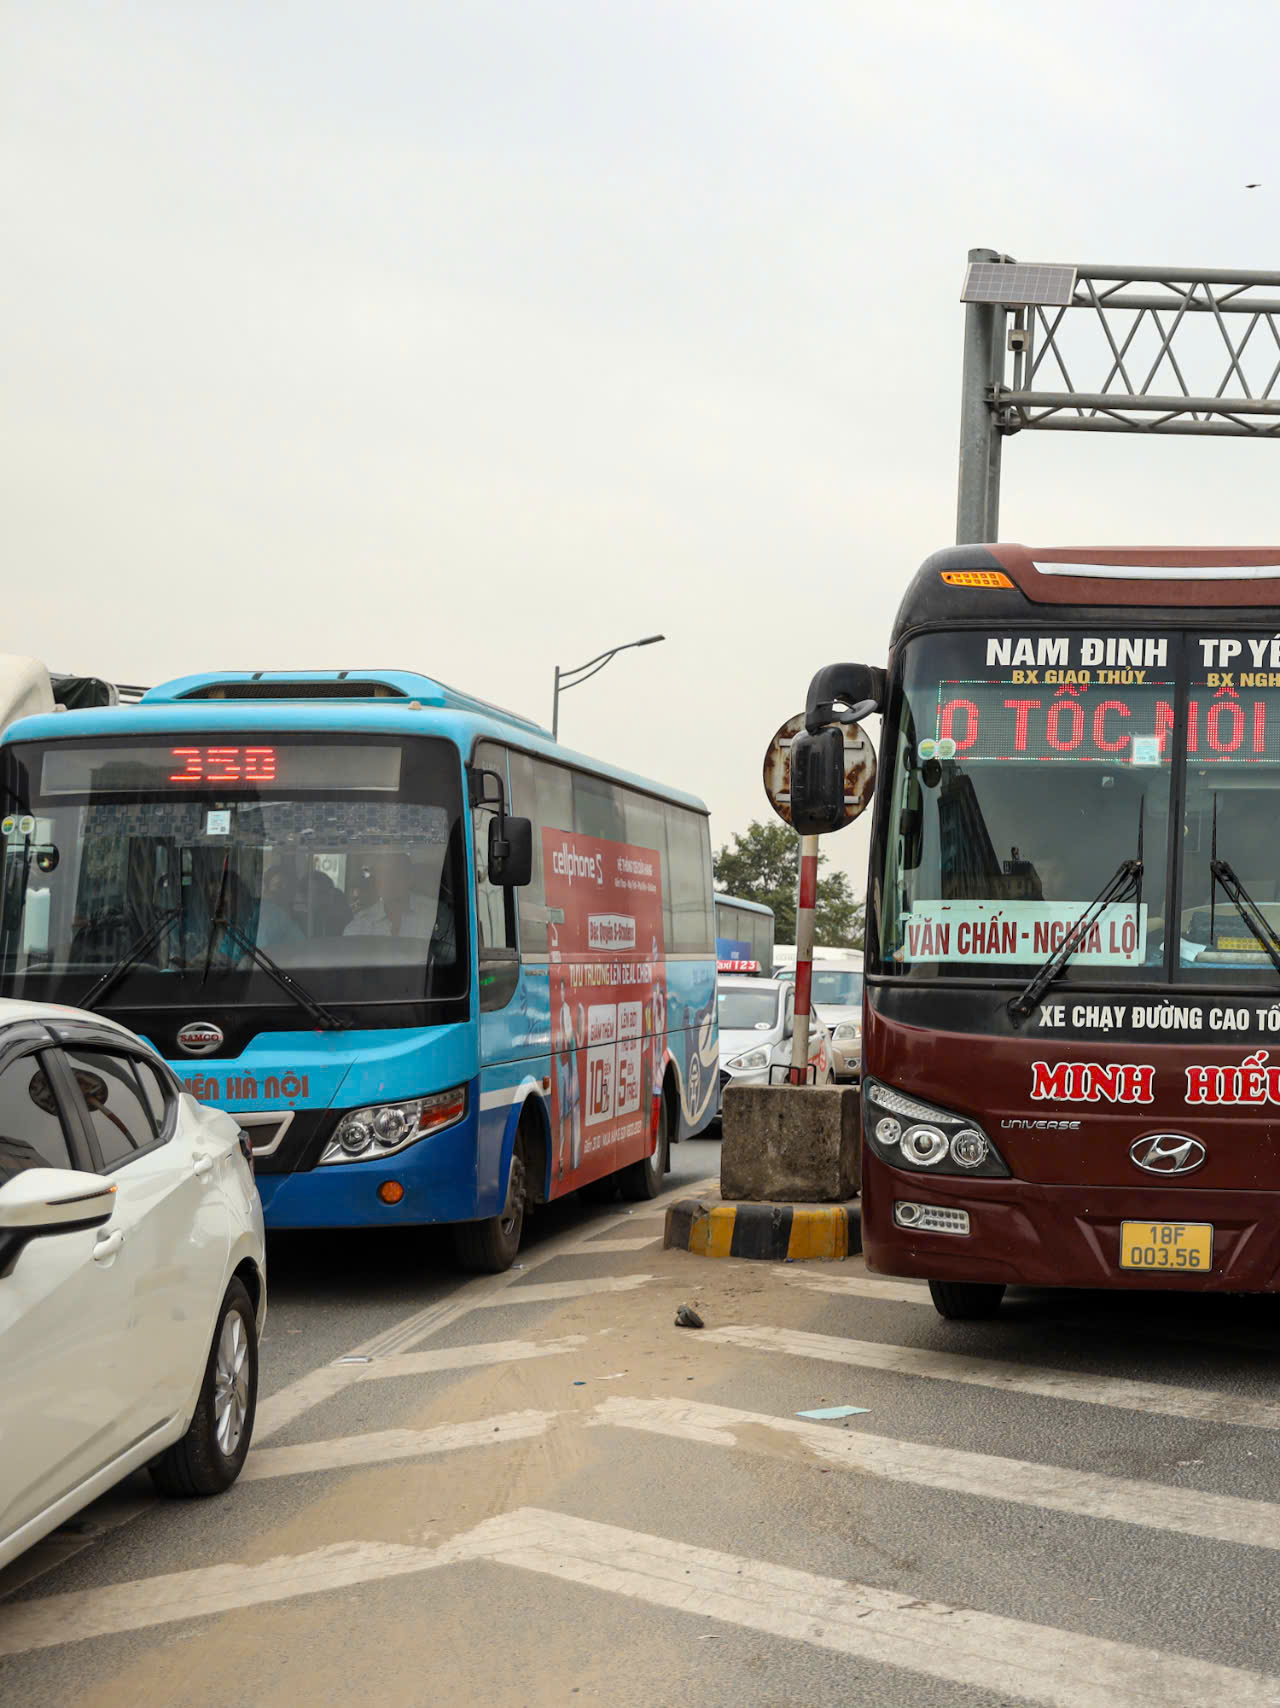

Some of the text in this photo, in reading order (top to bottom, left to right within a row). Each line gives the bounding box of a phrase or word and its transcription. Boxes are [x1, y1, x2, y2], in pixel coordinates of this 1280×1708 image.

[986, 638, 1070, 666] NAM
[1199, 639, 1242, 667] TP
[1012, 666, 1146, 685] BX GIAO THỦY
[1207, 672, 1234, 687] BX
[1004, 683, 1131, 752] TỐC
[909, 917, 950, 957] VĂN
[957, 911, 1017, 955] CHẤN
[1109, 914, 1136, 960] LỘ
[735, 960, 756, 970] 123
[1039, 1005, 1066, 1028] XE
[1072, 1005, 1126, 1032] CHẠY
[1131, 1000, 1202, 1030] ĐƯỜNG
[1209, 1007, 1250, 1031] CAO
[179, 1033, 220, 1044] SAMCO
[226, 1069, 258, 1100] HÀ
[264, 1070, 309, 1107] NỘI
[1030, 1061, 1155, 1104] MINH
[1000, 1119, 1081, 1130] UNIVERSE
[1150, 1225, 1186, 1246] 18F
[1130, 1246, 1201, 1267] 003.56
